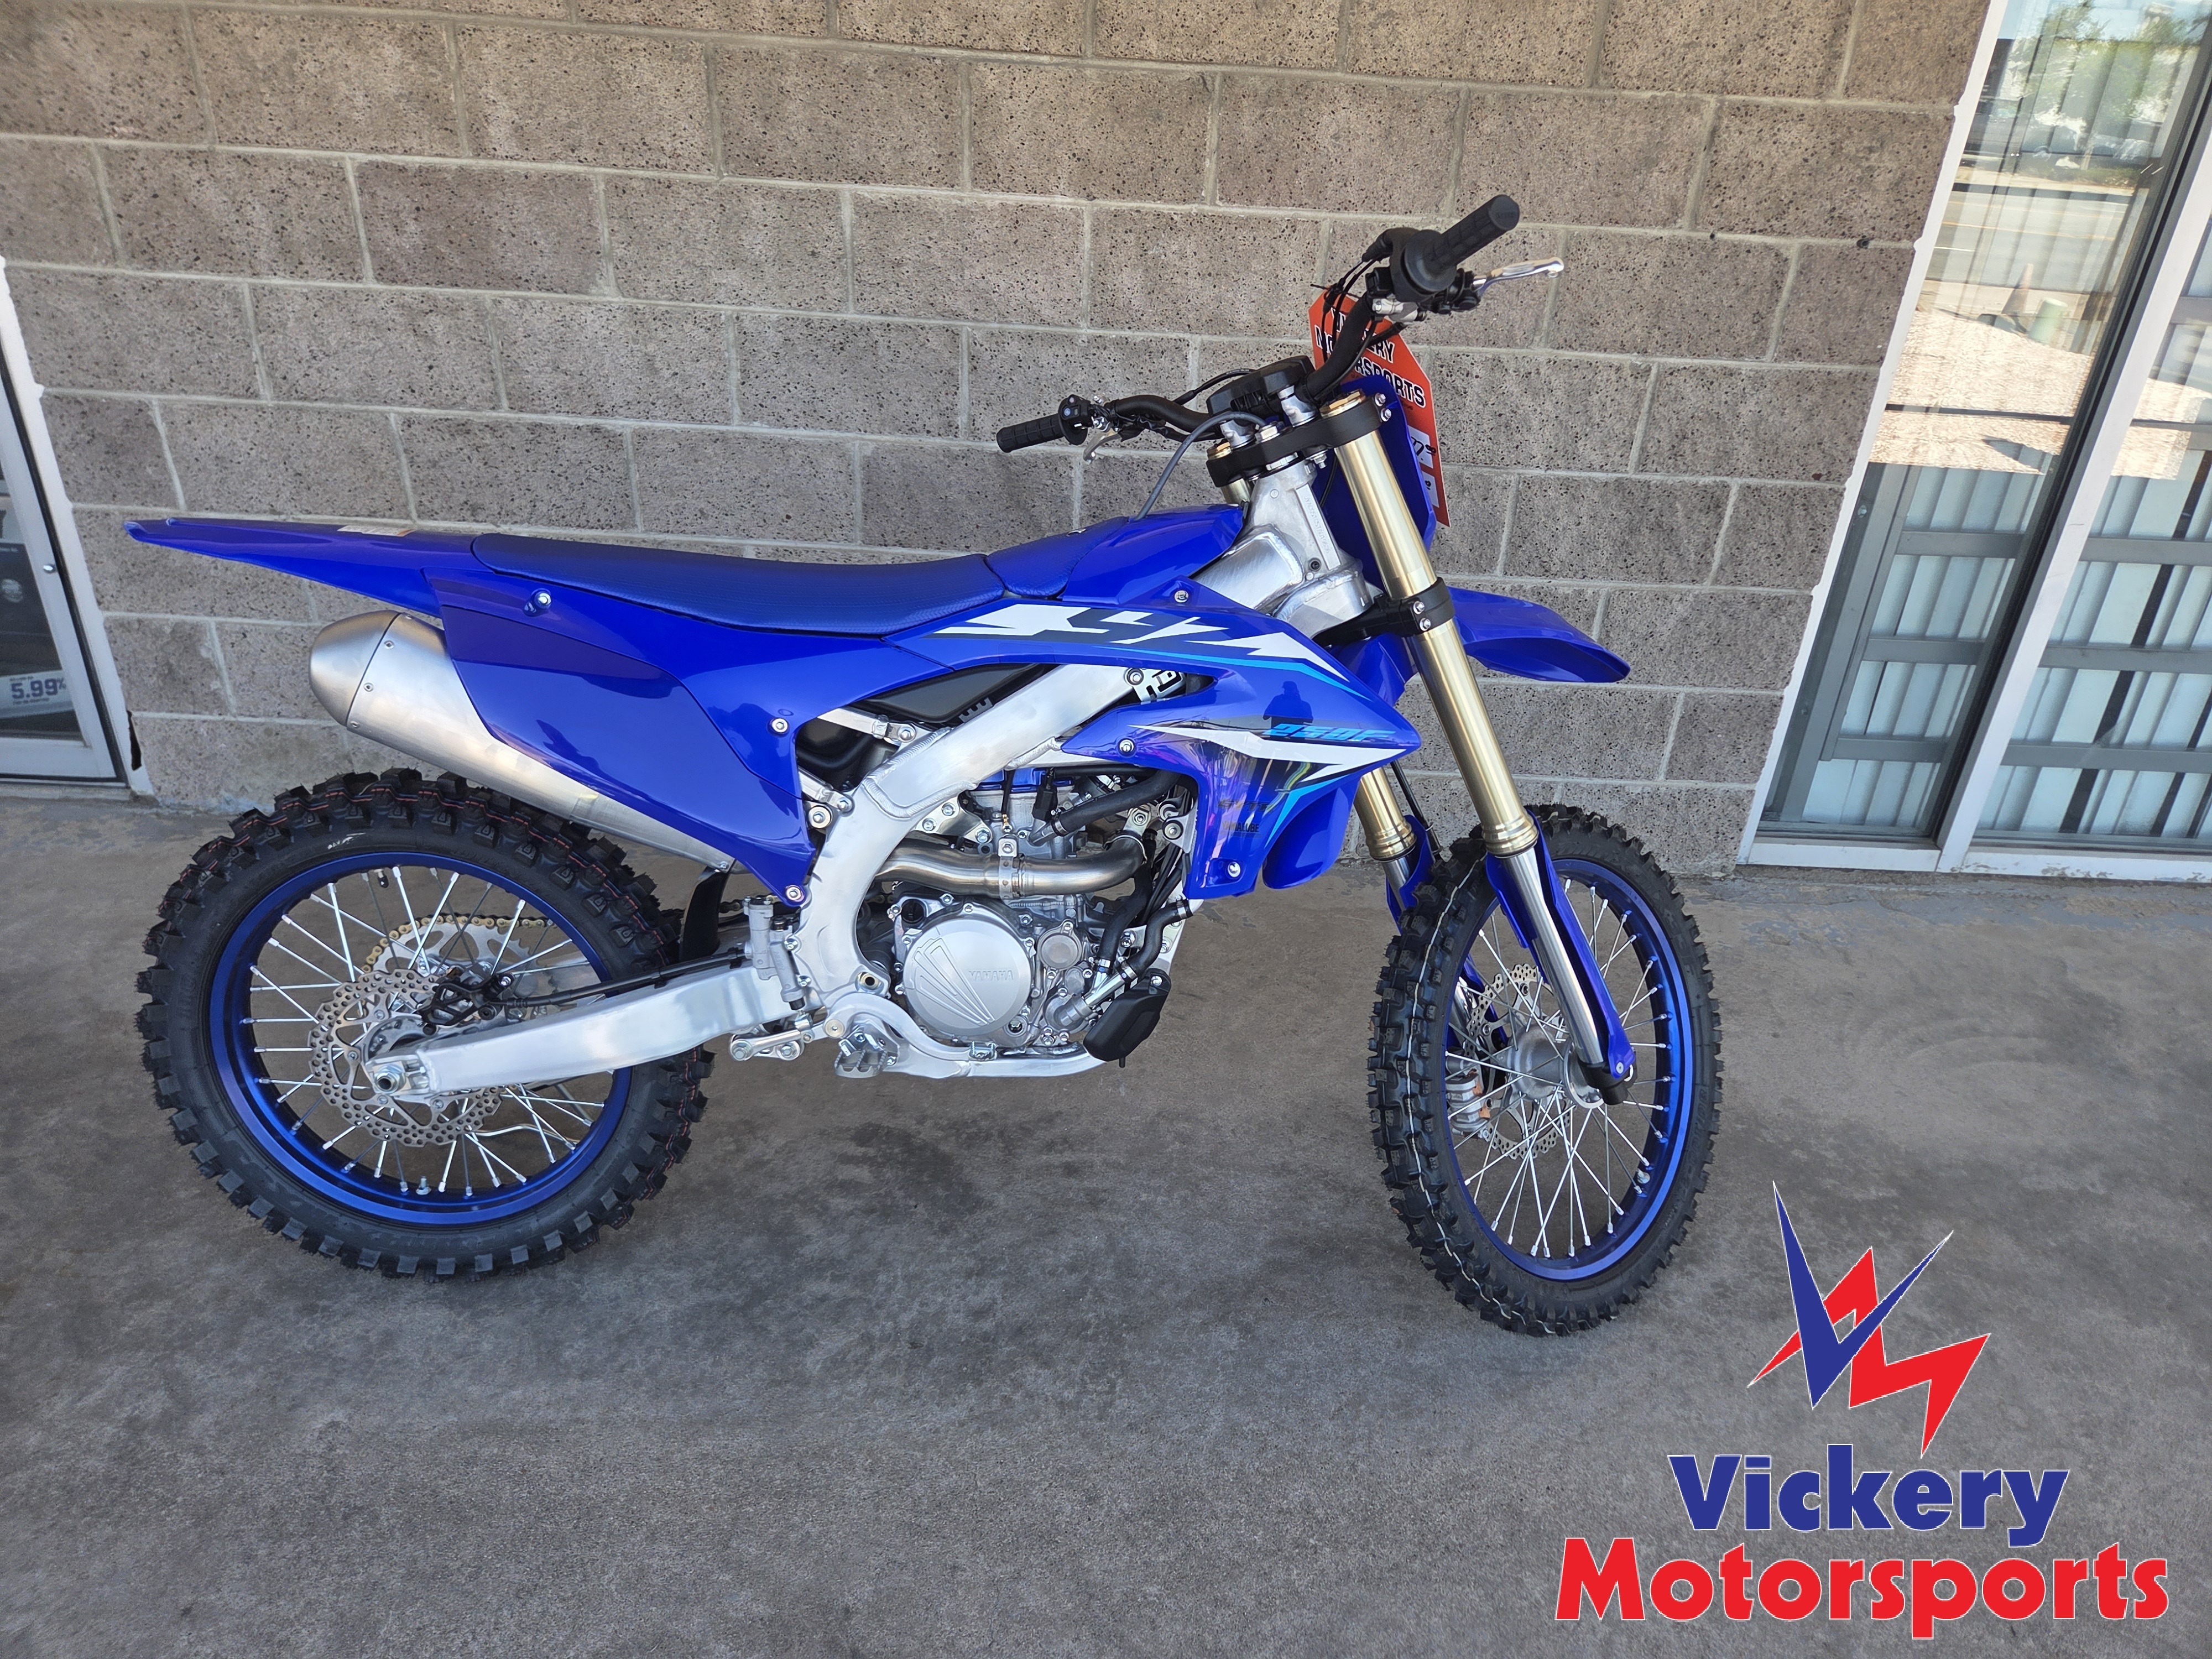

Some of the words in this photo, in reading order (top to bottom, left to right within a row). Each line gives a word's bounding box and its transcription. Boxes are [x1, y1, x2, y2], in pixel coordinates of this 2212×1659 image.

[1262, 723, 1396, 743] 250F
[1222, 821, 1260, 833] YAMALUBE
[968, 969, 1014, 982] YAMAHA
